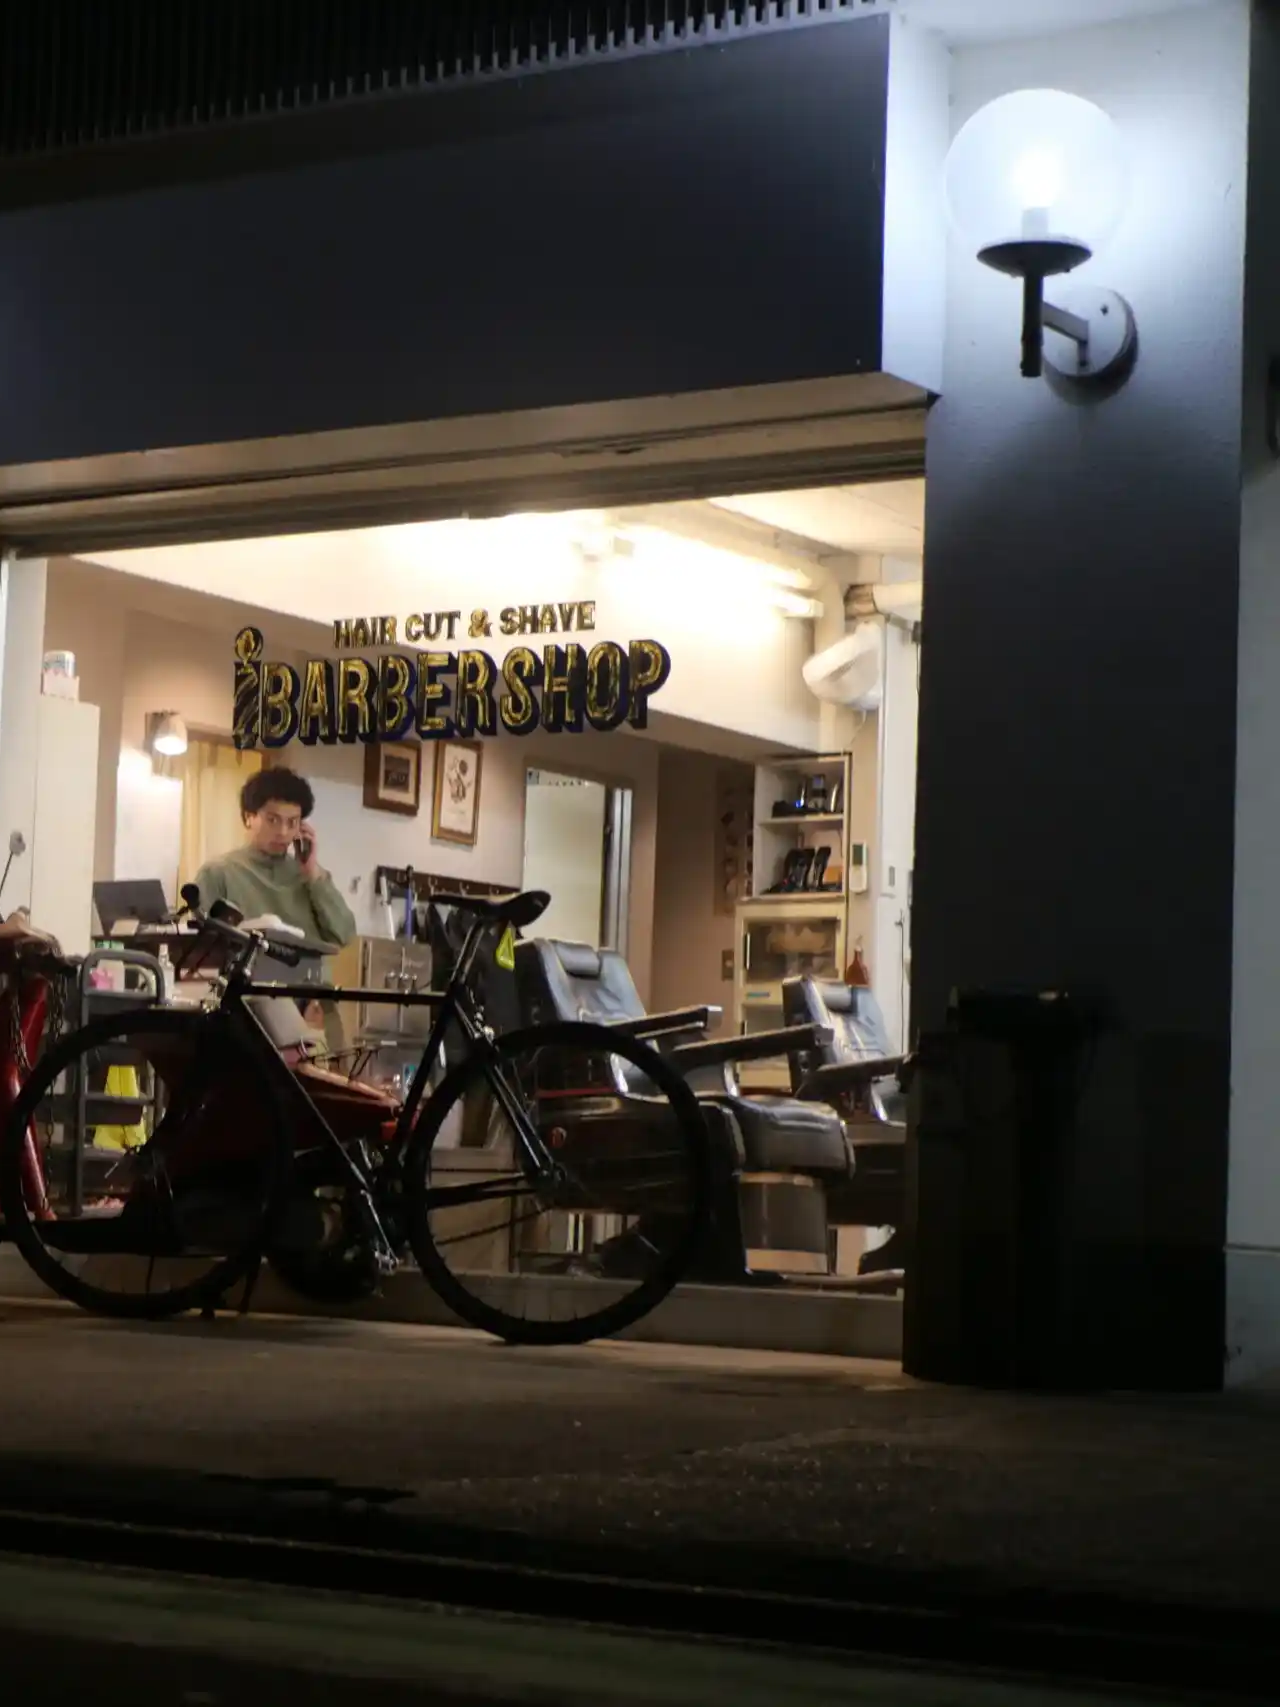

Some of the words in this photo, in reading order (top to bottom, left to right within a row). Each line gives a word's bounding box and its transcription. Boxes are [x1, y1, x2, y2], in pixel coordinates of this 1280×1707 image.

[334, 615, 398, 649] HAIR
[405, 610, 461, 643] CUT
[468, 608, 493, 638] &
[500, 600, 596, 636] SHAVE
[261, 639, 671, 748] BARBERSHOP
